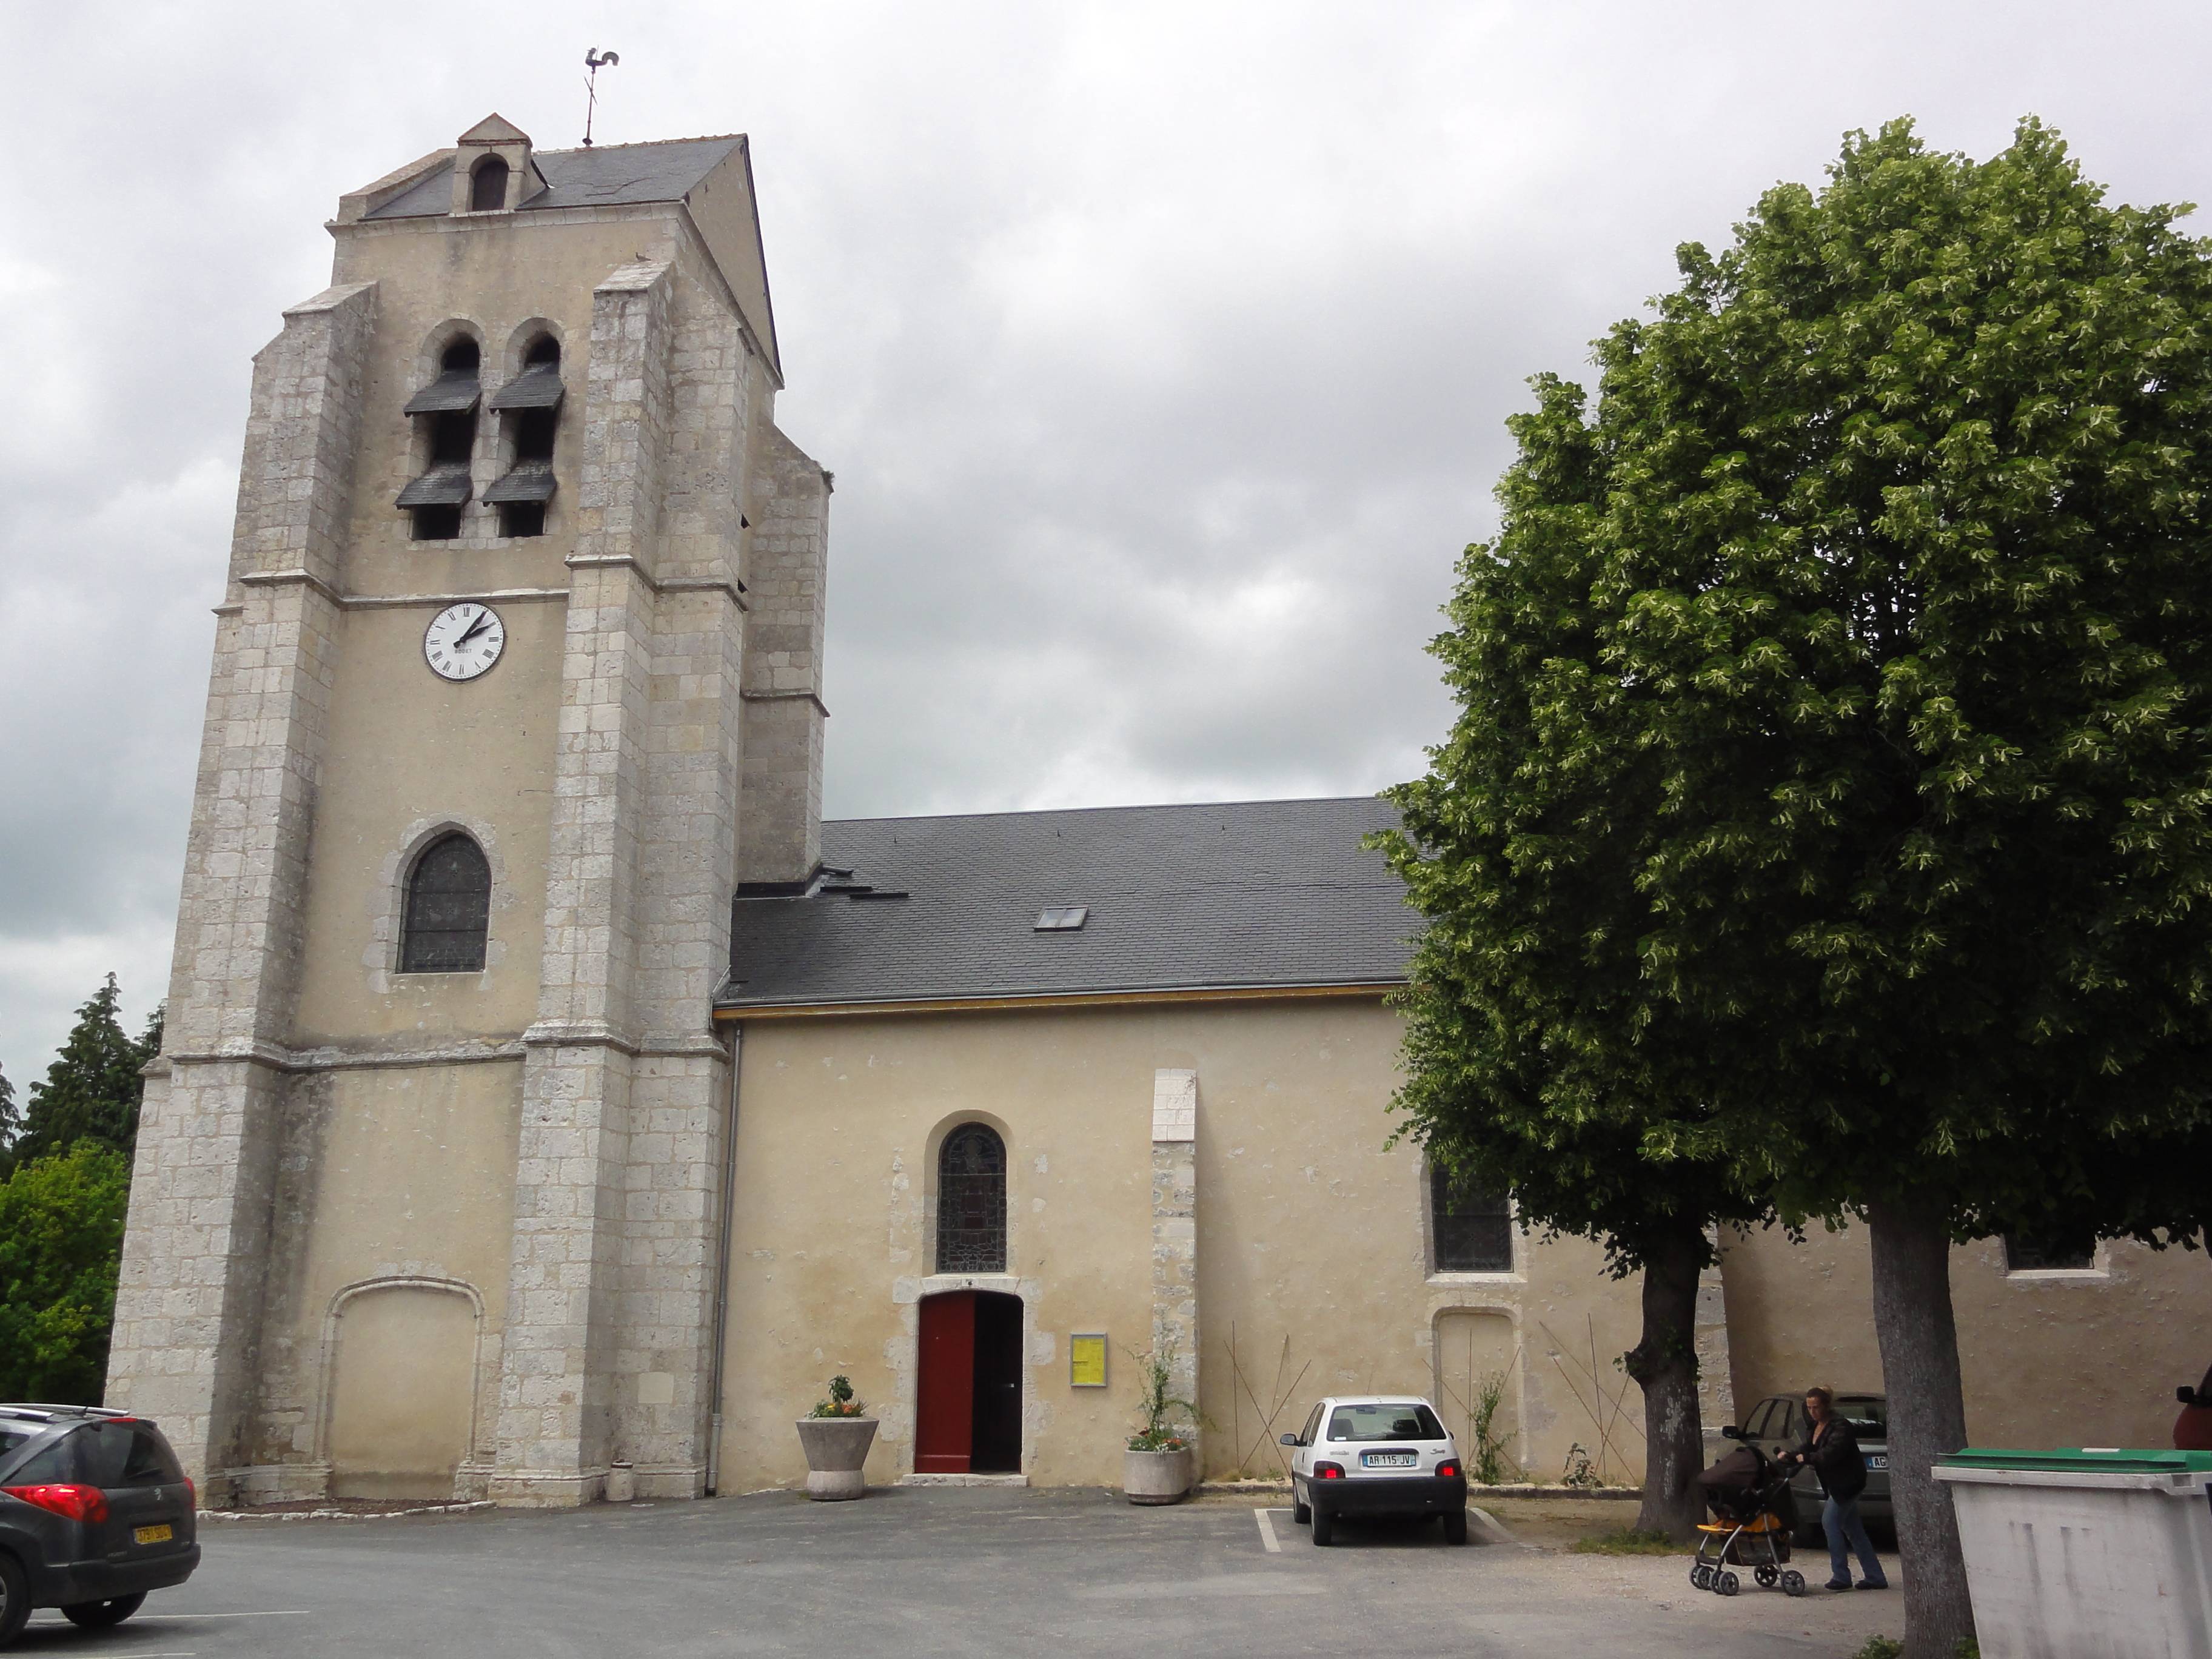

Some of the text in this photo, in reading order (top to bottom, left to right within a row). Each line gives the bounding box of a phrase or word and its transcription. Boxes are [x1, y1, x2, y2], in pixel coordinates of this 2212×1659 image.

[1369, 1456, 1410, 1464] AR 115 JV
[1874, 1457, 1886, 1466] AG
